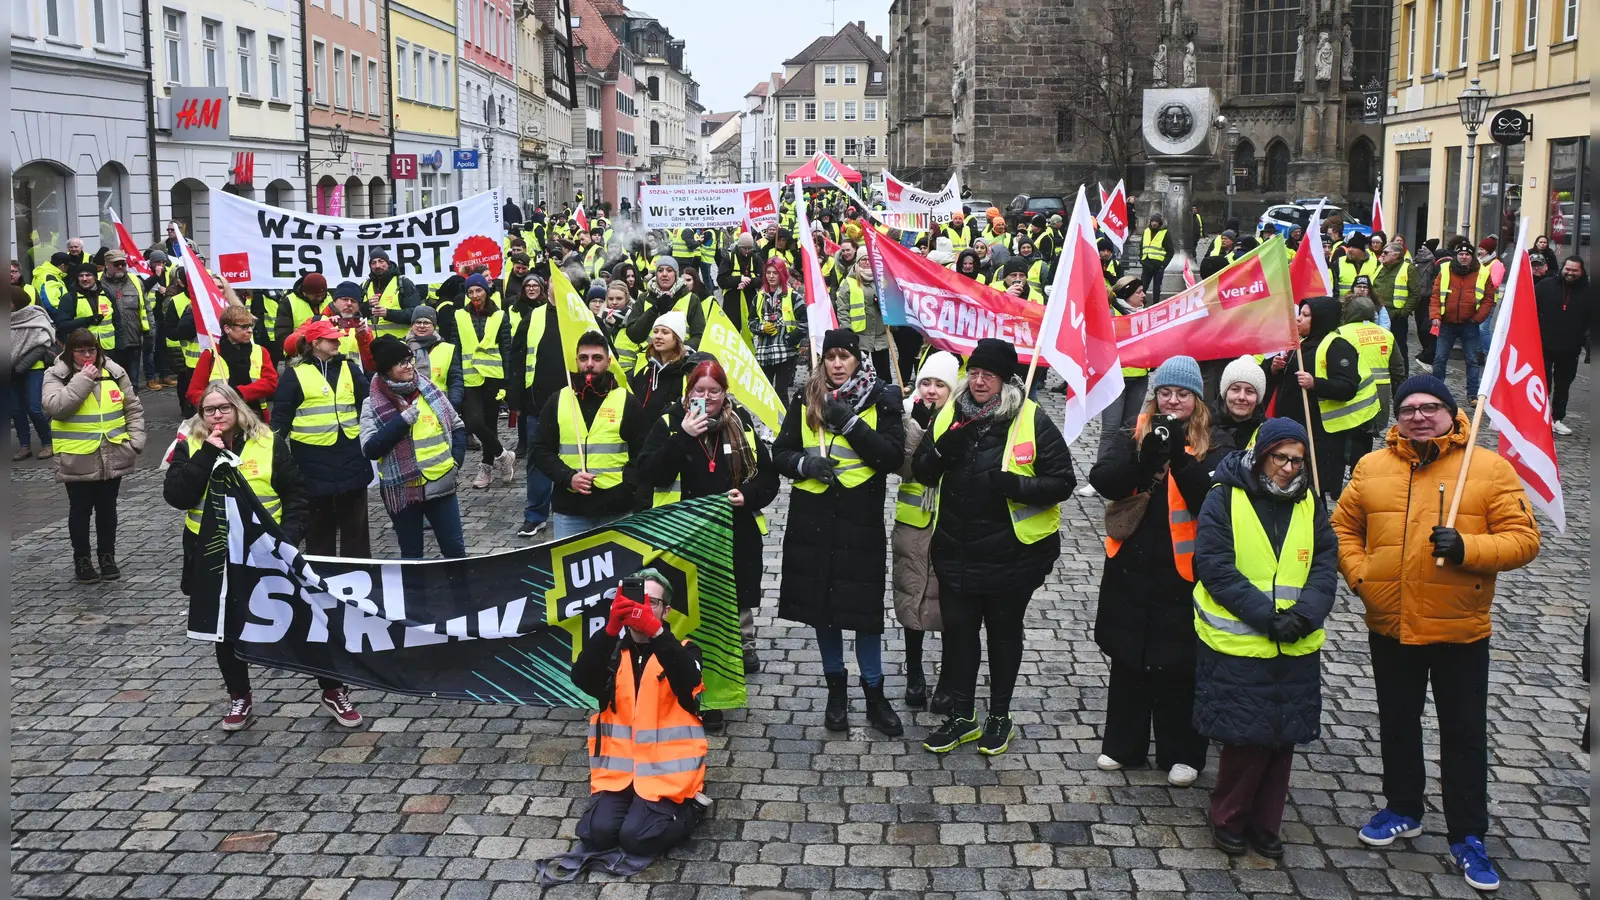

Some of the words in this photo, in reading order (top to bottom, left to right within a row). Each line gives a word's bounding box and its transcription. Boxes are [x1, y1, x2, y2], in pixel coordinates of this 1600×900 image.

[176, 98, 222, 129] H&M
[234, 151, 254, 185] H&M
[396, 158, 411, 175] T
[257, 209, 345, 240] WIR
[357, 206, 460, 239] SIND
[649, 205, 675, 216] Wir
[679, 204, 735, 216] streiken
[271, 244, 323, 278] ES
[456, 254, 500, 267] ÖFFENTLICHER
[1220, 280, 1264, 299] ver.di
[1130, 286, 1206, 336] MEHR
[1356, 329, 1384, 337] ZUSAMMEN
[718, 349, 776, 411] STARK
[570, 550, 614, 588] UN
